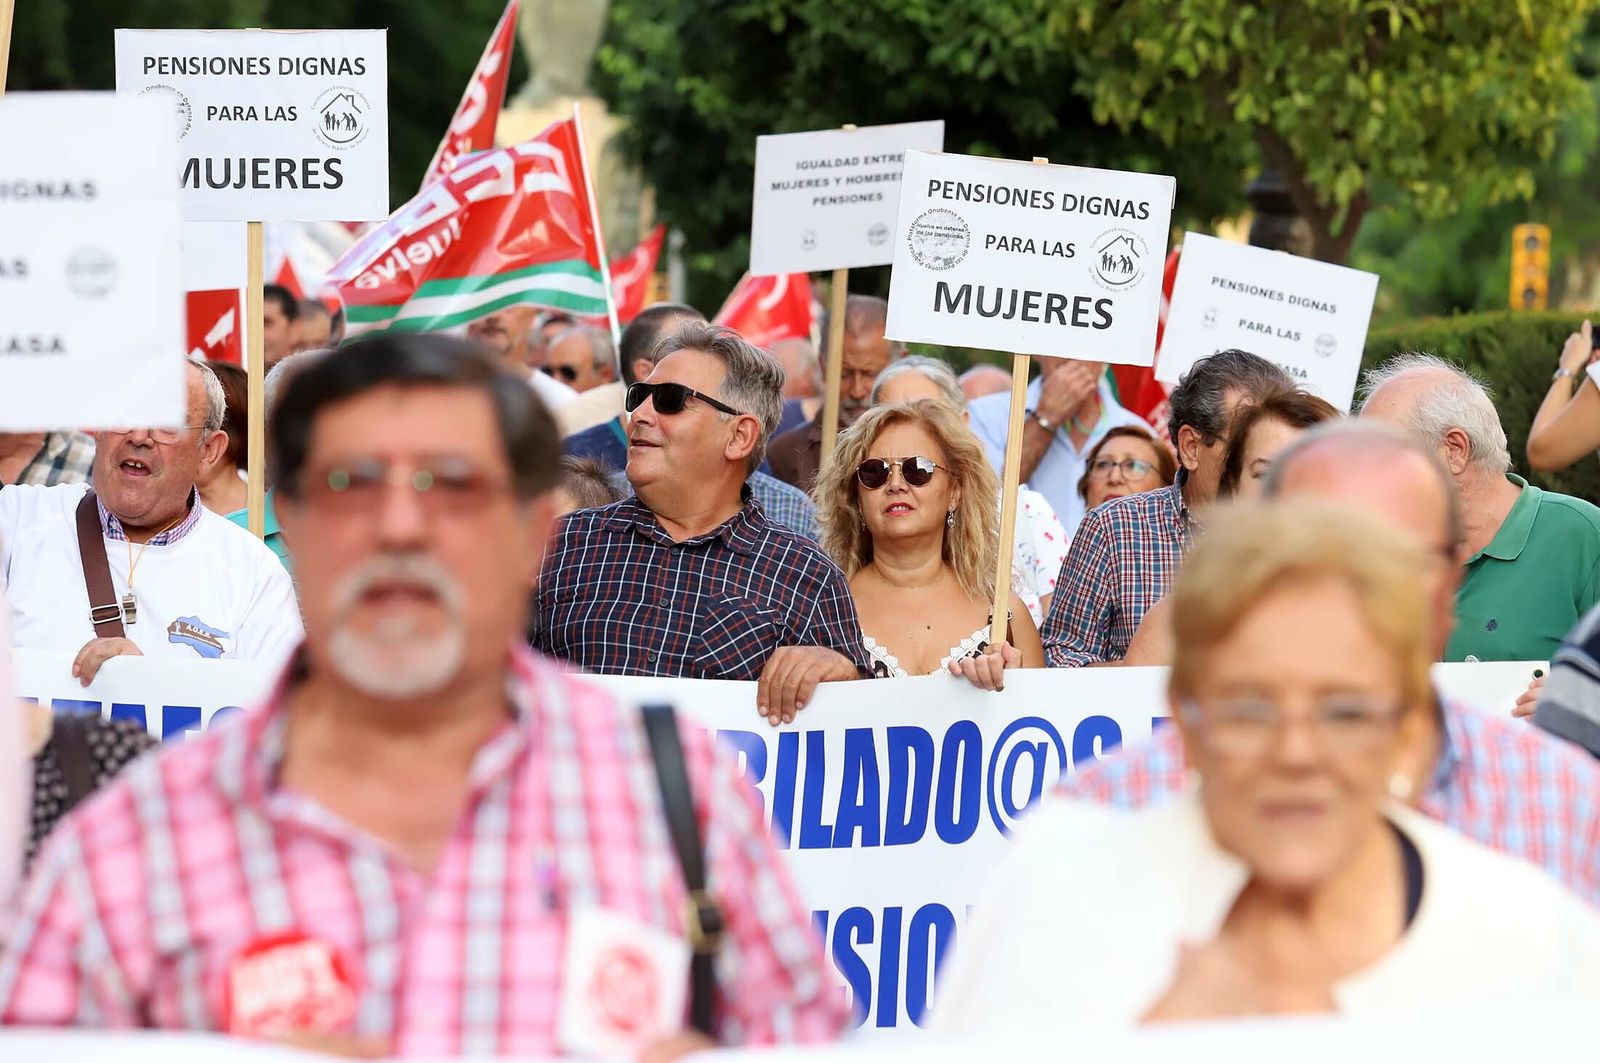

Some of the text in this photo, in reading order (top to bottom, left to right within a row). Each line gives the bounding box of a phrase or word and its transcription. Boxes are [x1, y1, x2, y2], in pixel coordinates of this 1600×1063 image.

[143, 56, 366, 76] PENSIONES DIGNAS
[207, 105, 298, 122] PARA LAS
[796, 152, 903, 171] IGUALDAD ENTRE
[180, 157, 344, 190] MUJERES
[770, 177, 830, 191] MUJERES
[833, 176, 842, 187] Y
[0, 180, 97, 200] IGNAS
[812, 191, 884, 207] PENSIONES
[927, 179, 1150, 220] PENSIONES DIGNAS
[927, 207, 957, 217] Onubense
[984, 234, 1036, 255] PARA
[1042, 240, 1076, 259] LAS
[1211, 276, 1338, 314] PENSIONES DIGNAS
[933, 281, 1114, 330] MUJERES
[1238, 319, 1302, 342] PARA LAS
[0, 336, 66, 355] ASA
